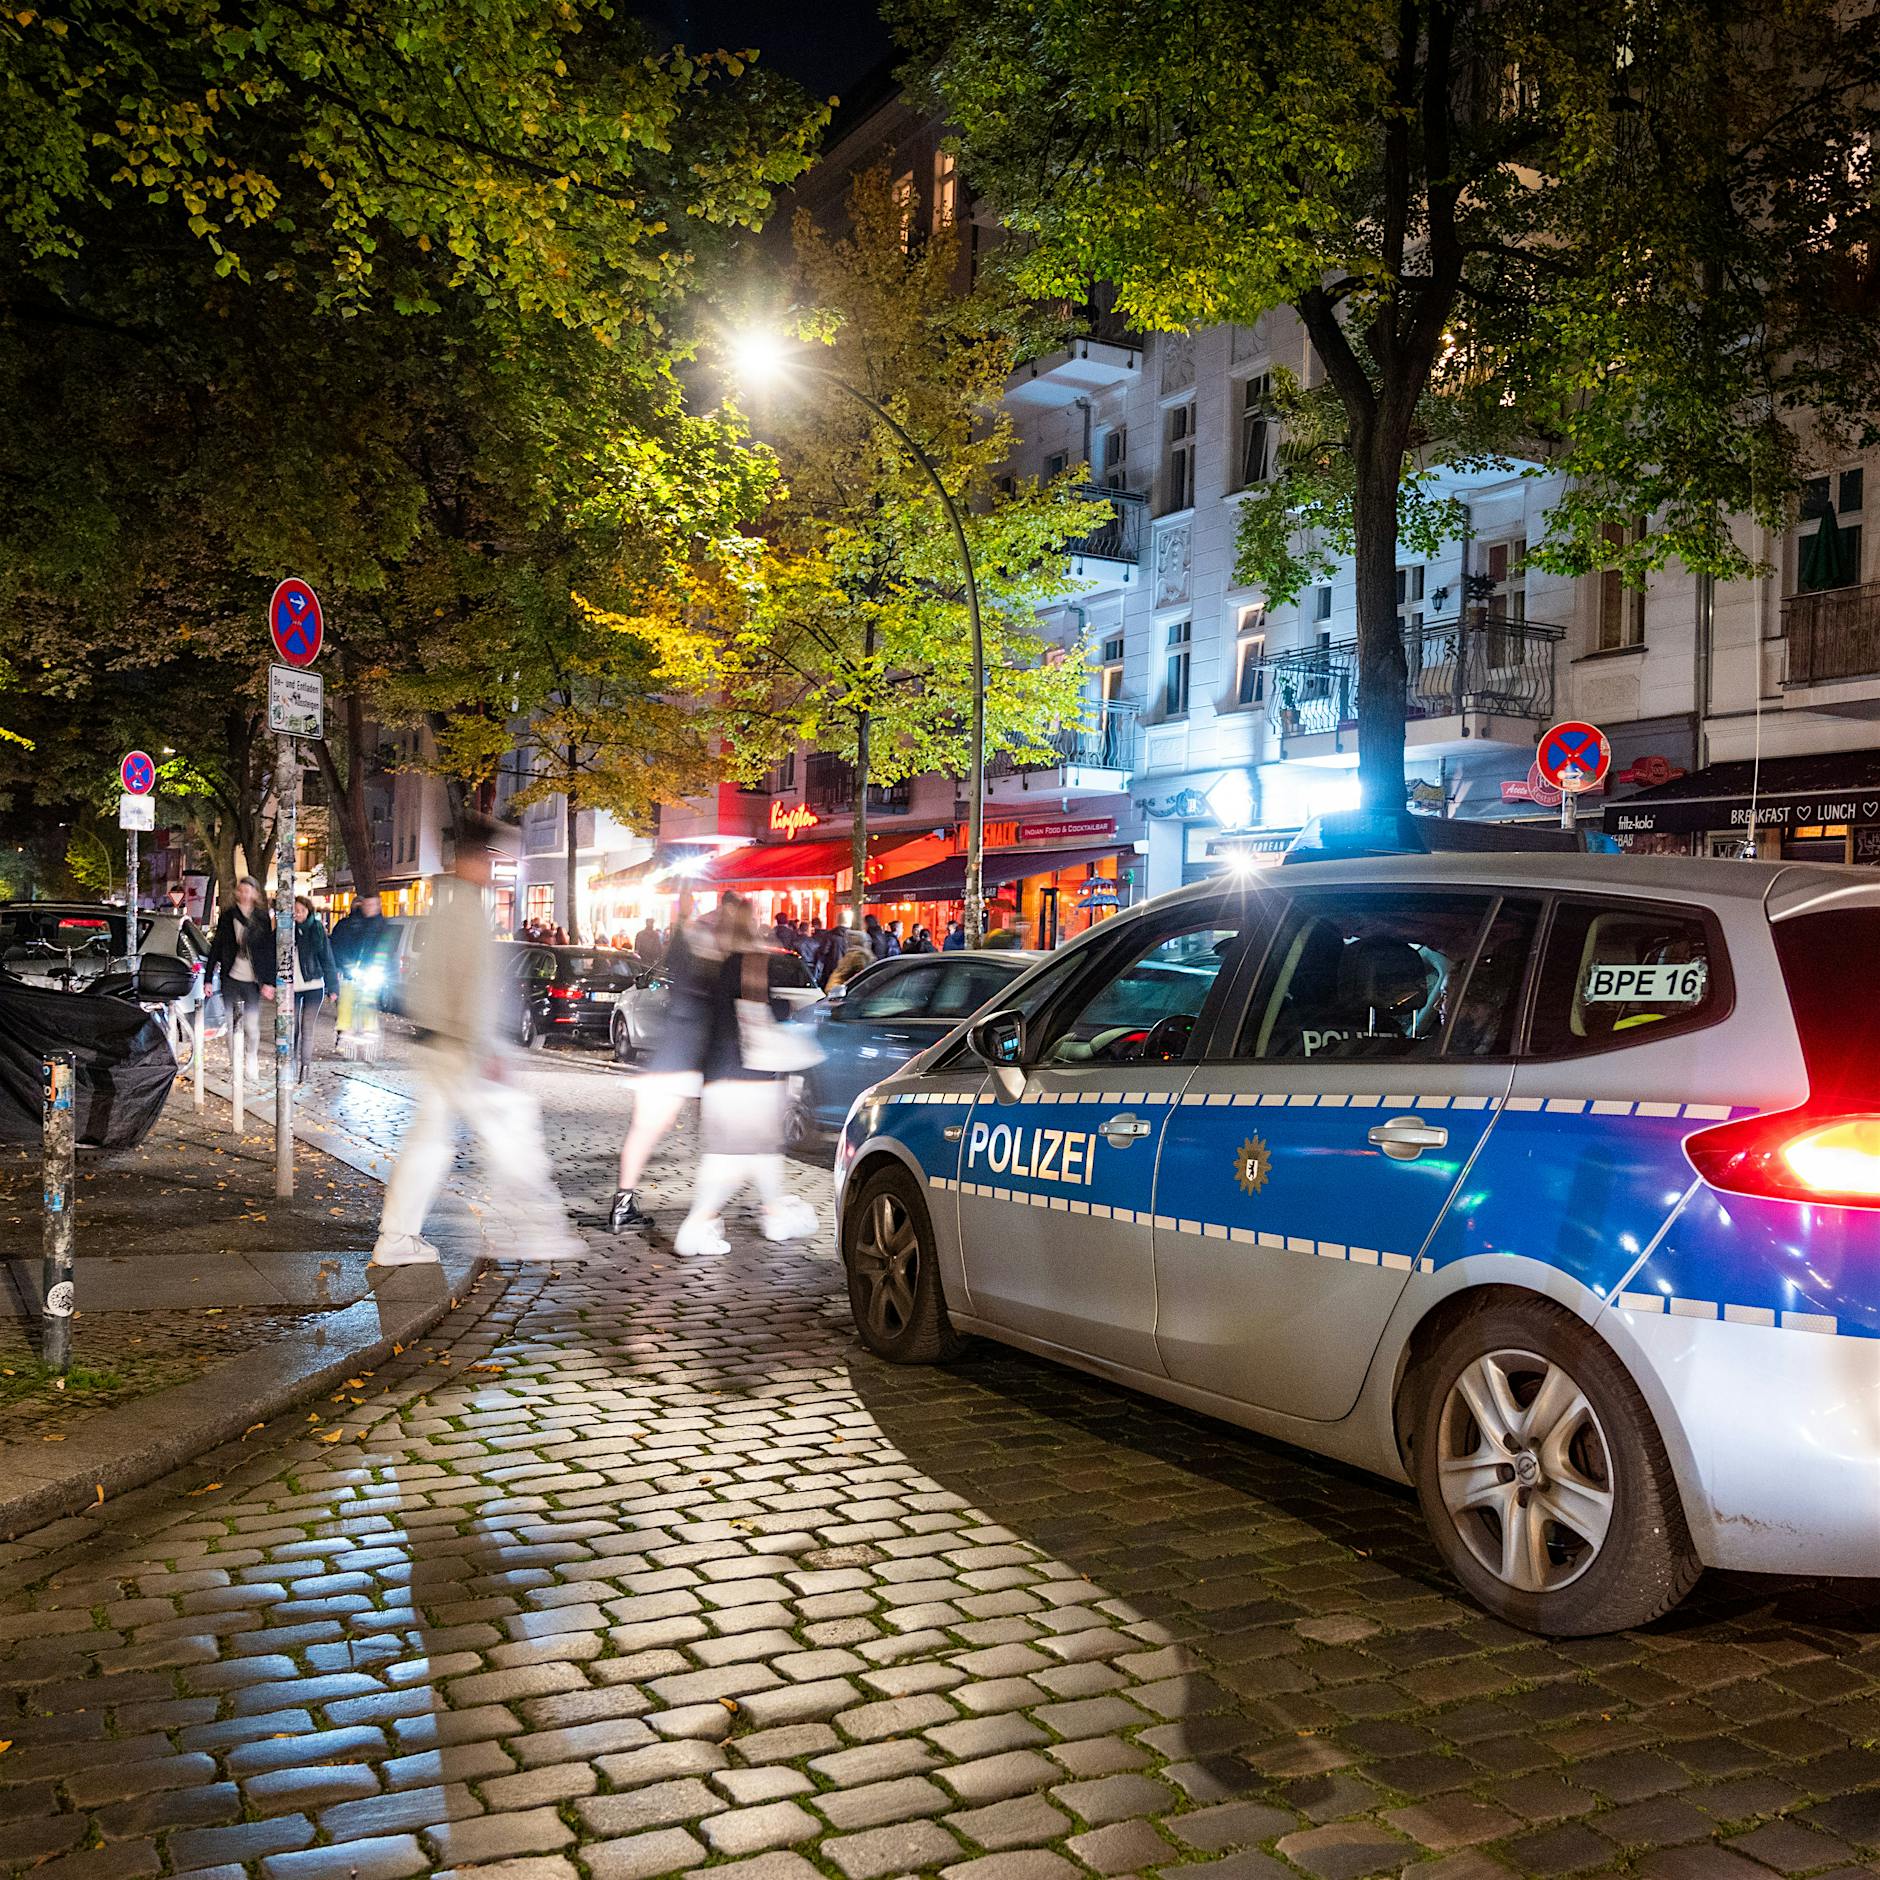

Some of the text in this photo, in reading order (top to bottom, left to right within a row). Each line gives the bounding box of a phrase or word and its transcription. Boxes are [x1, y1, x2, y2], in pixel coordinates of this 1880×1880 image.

[1817, 803, 1857, 821] LUNCH
[1061, 825, 1068, 833] &
[1252, 841, 1283, 851] KOREAN
[1594, 969, 1699, 996] BPE 16
[968, 1121, 1097, 1186] POLIZEI
